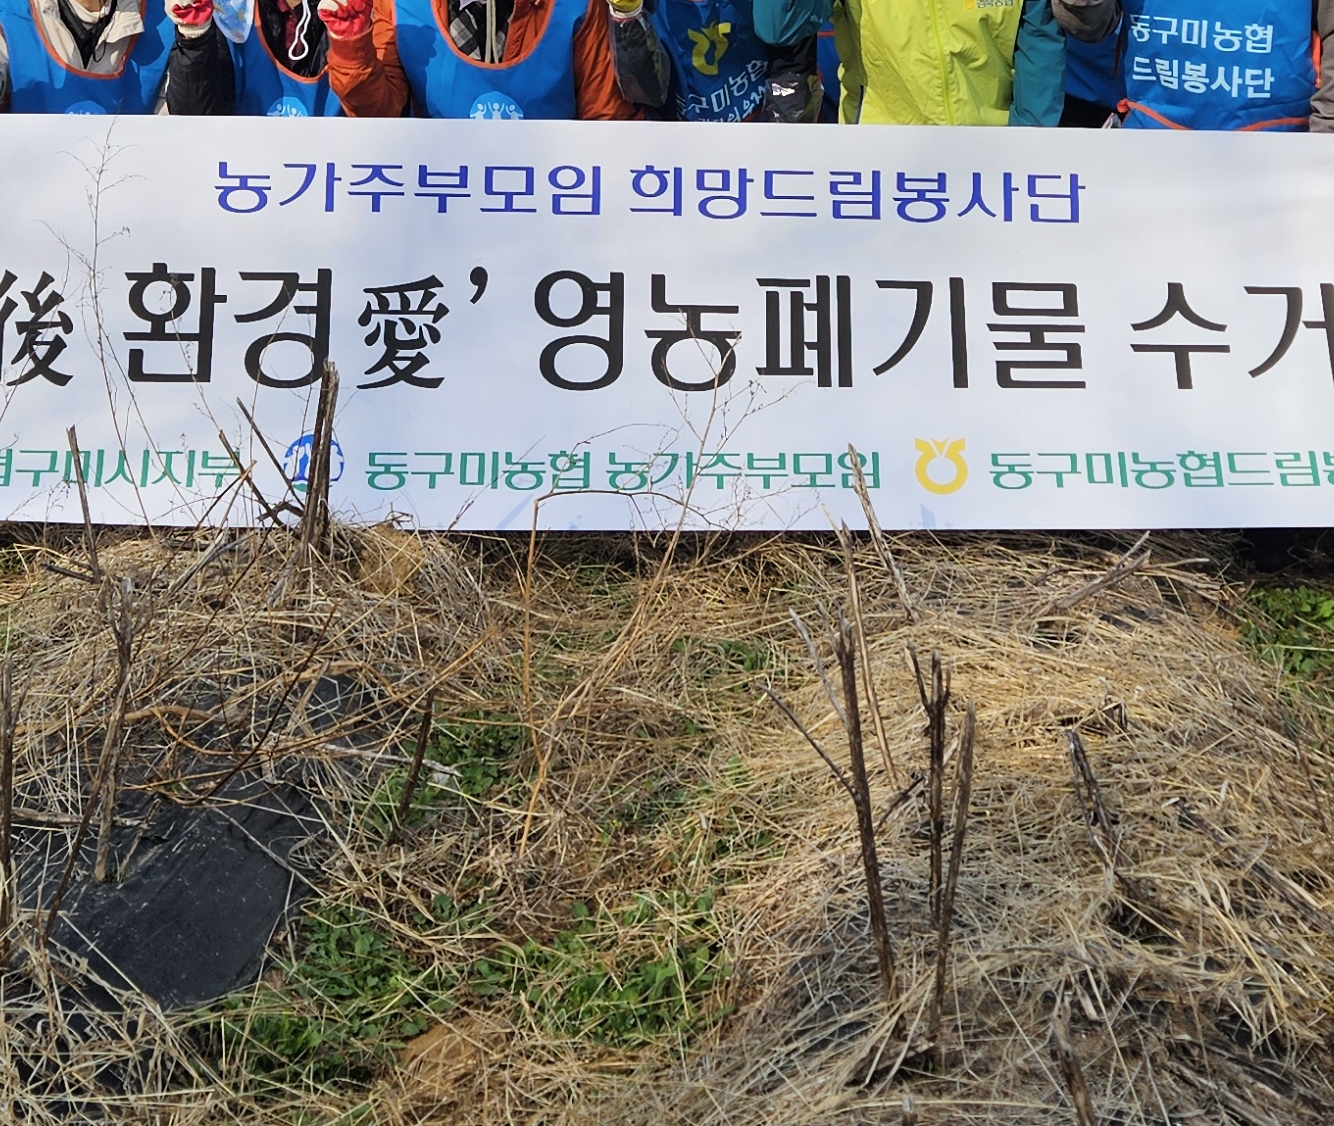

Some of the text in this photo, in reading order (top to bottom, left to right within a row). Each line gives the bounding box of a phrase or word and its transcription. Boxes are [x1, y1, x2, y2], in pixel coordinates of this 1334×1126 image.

[1130, 13, 1274, 54] 동구미농협
[1132, 56, 1275, 99] 드림봉사단
[215, 162, 1087, 224] 농가주부모임 희망드림봉사단
[534, 269, 1087, 391] 영농폐기물
[364, 448, 881, 492] 동구미농협 농가주부모임
